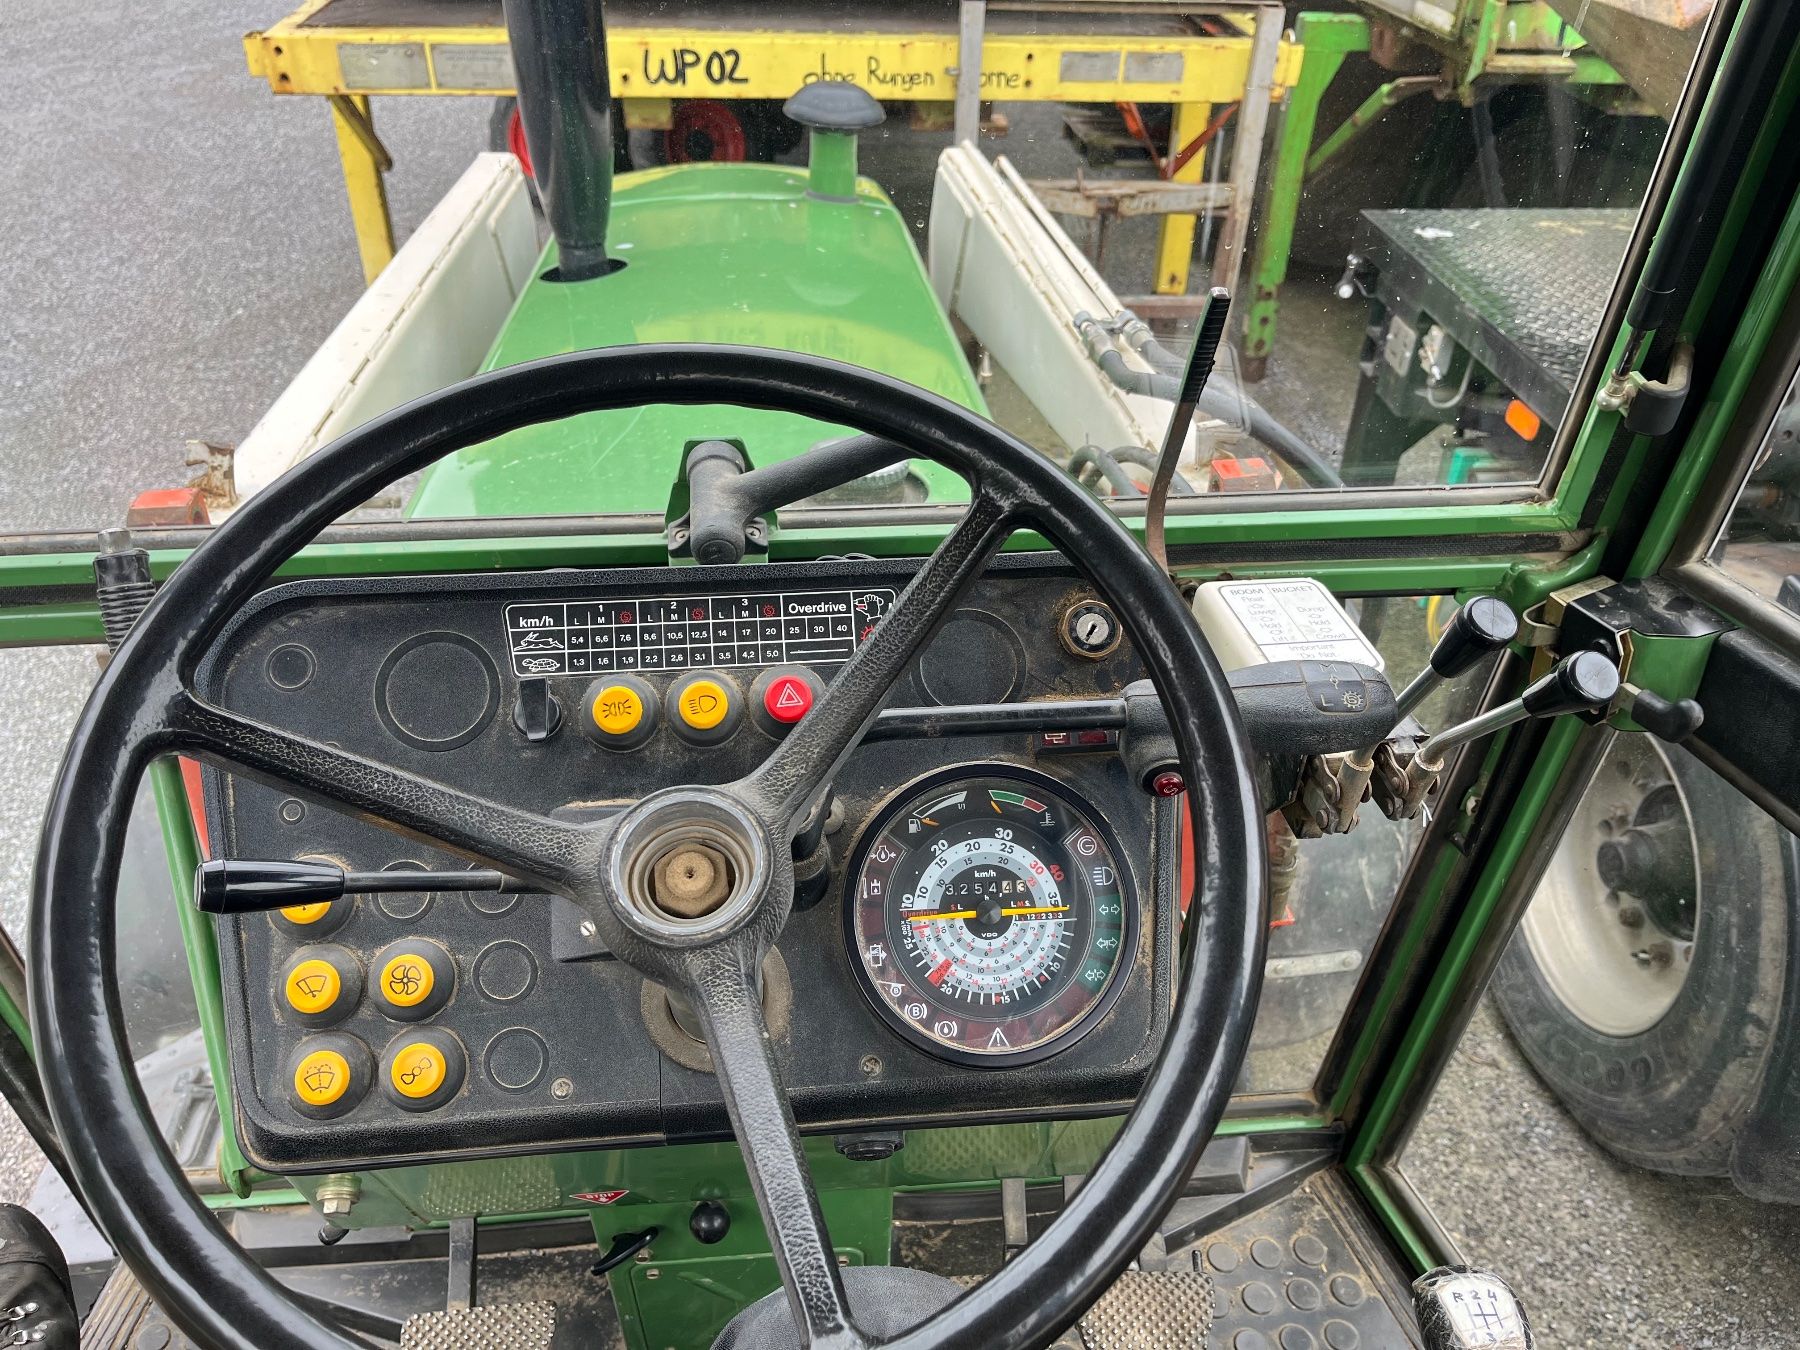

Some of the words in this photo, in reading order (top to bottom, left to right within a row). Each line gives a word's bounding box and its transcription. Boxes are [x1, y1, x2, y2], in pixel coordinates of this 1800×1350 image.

[867, 56, 935, 91] Rungen
[1230, 588, 1264, 596] BOOM
[1271, 585, 1313, 593] BUCKET
[520, 616, 554, 628] km/h
[788, 602, 847, 614] Overdrive
[1248, 608, 1276, 616] Lower
[571, 636, 584, 644] 5,4
[667, 632, 683, 640] 10,5
[691, 630, 708, 639] 12,5
[766, 650, 779, 658] 5,0
[1319, 664, 1337, 672] M
[1320, 694, 1334, 706] L
[994, 828, 1013, 840] 30
[930, 839, 949, 857] 20
[964, 841, 981, 852] 20
[1000, 843, 1015, 854] 25
[934, 856, 948, 870] 15
[964, 857, 973, 866] 15
[998, 856, 1009, 866] 20
[1030, 860, 1044, 875] 30
[1050, 863, 1065, 882] 40
[974, 870, 996, 878] km/h
[936, 878, 946, 889] 10
[918, 886, 929, 899] 10
[901, 894, 914, 909] 10
[1048, 892, 1059, 907] 35
[904, 938, 914, 950] 25
[1050, 962, 1060, 972] 10
[940, 984, 952, 995] 20
[1001, 996, 1010, 1004] 15
[1452, 1292, 1464, 1302] R
[1471, 1290, 1482, 1300] 2
[1488, 1289, 1497, 1301] 4
